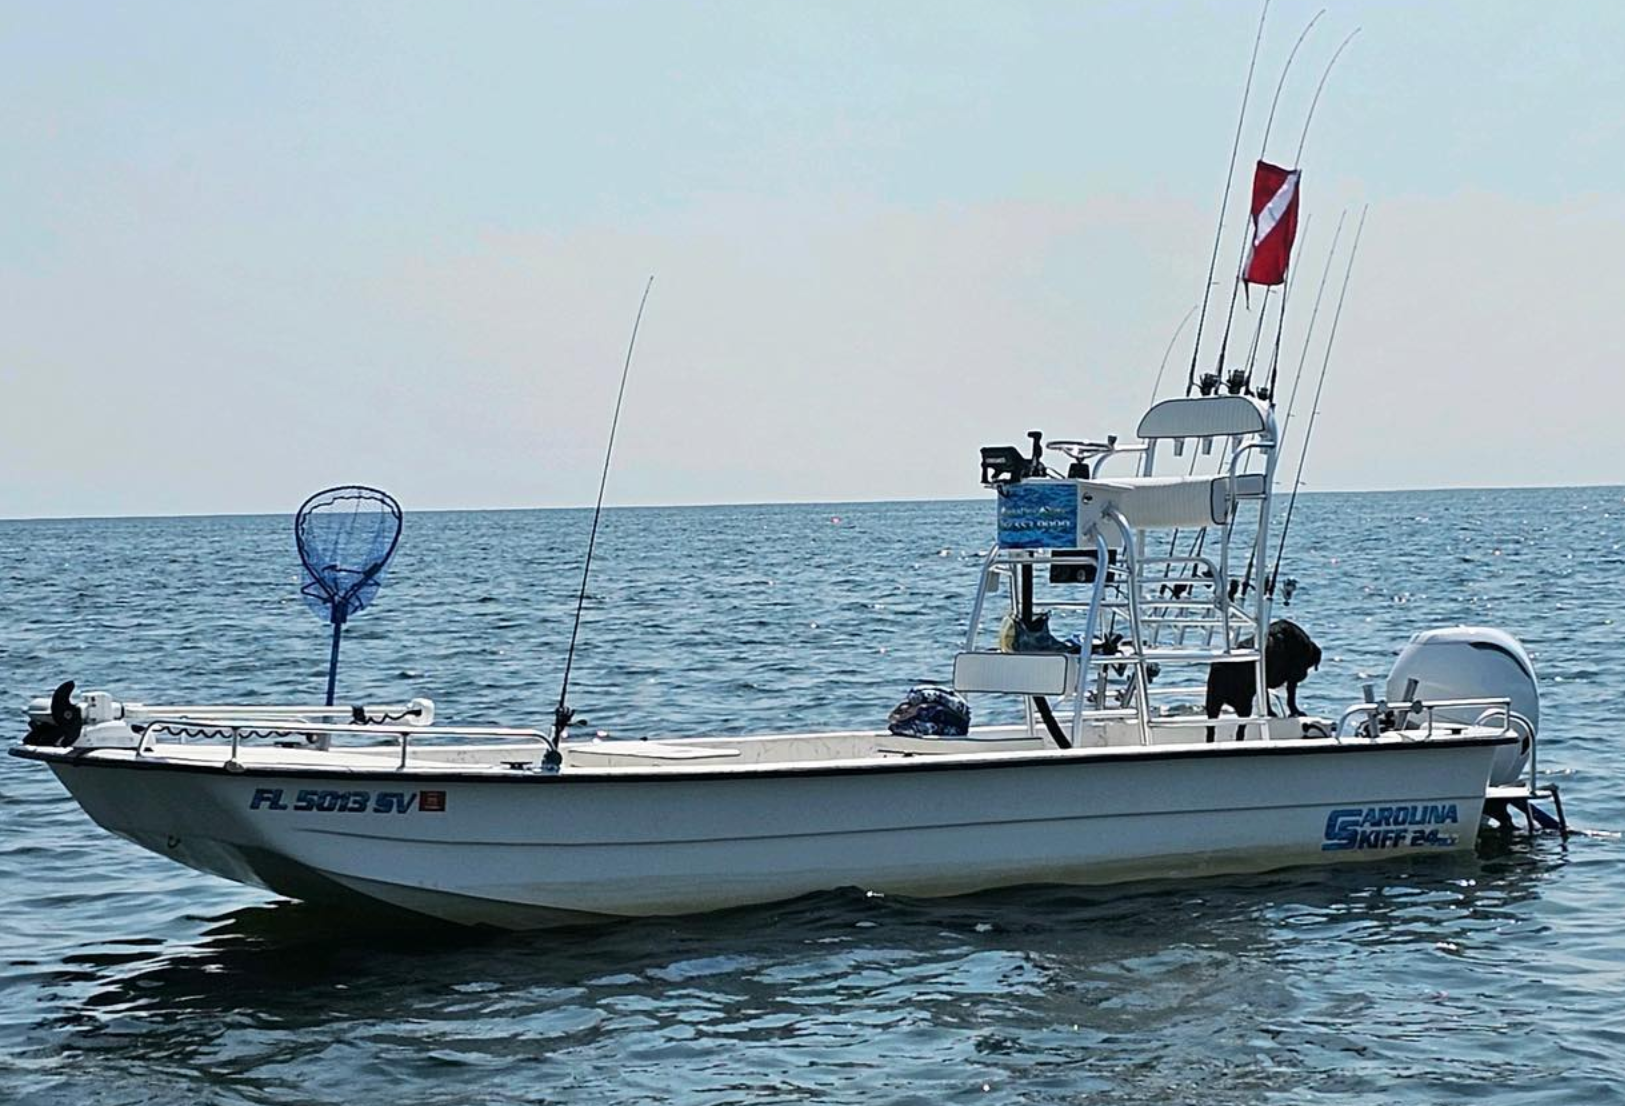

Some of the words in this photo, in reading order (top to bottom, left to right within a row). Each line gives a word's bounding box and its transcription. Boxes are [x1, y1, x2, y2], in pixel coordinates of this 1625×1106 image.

[249, 788, 288, 811] FL
[293, 789, 371, 812] 5013
[372, 791, 417, 814] SV
[1321, 820, 1407, 851] SKIFF
[1410, 829, 1440, 847] 24
